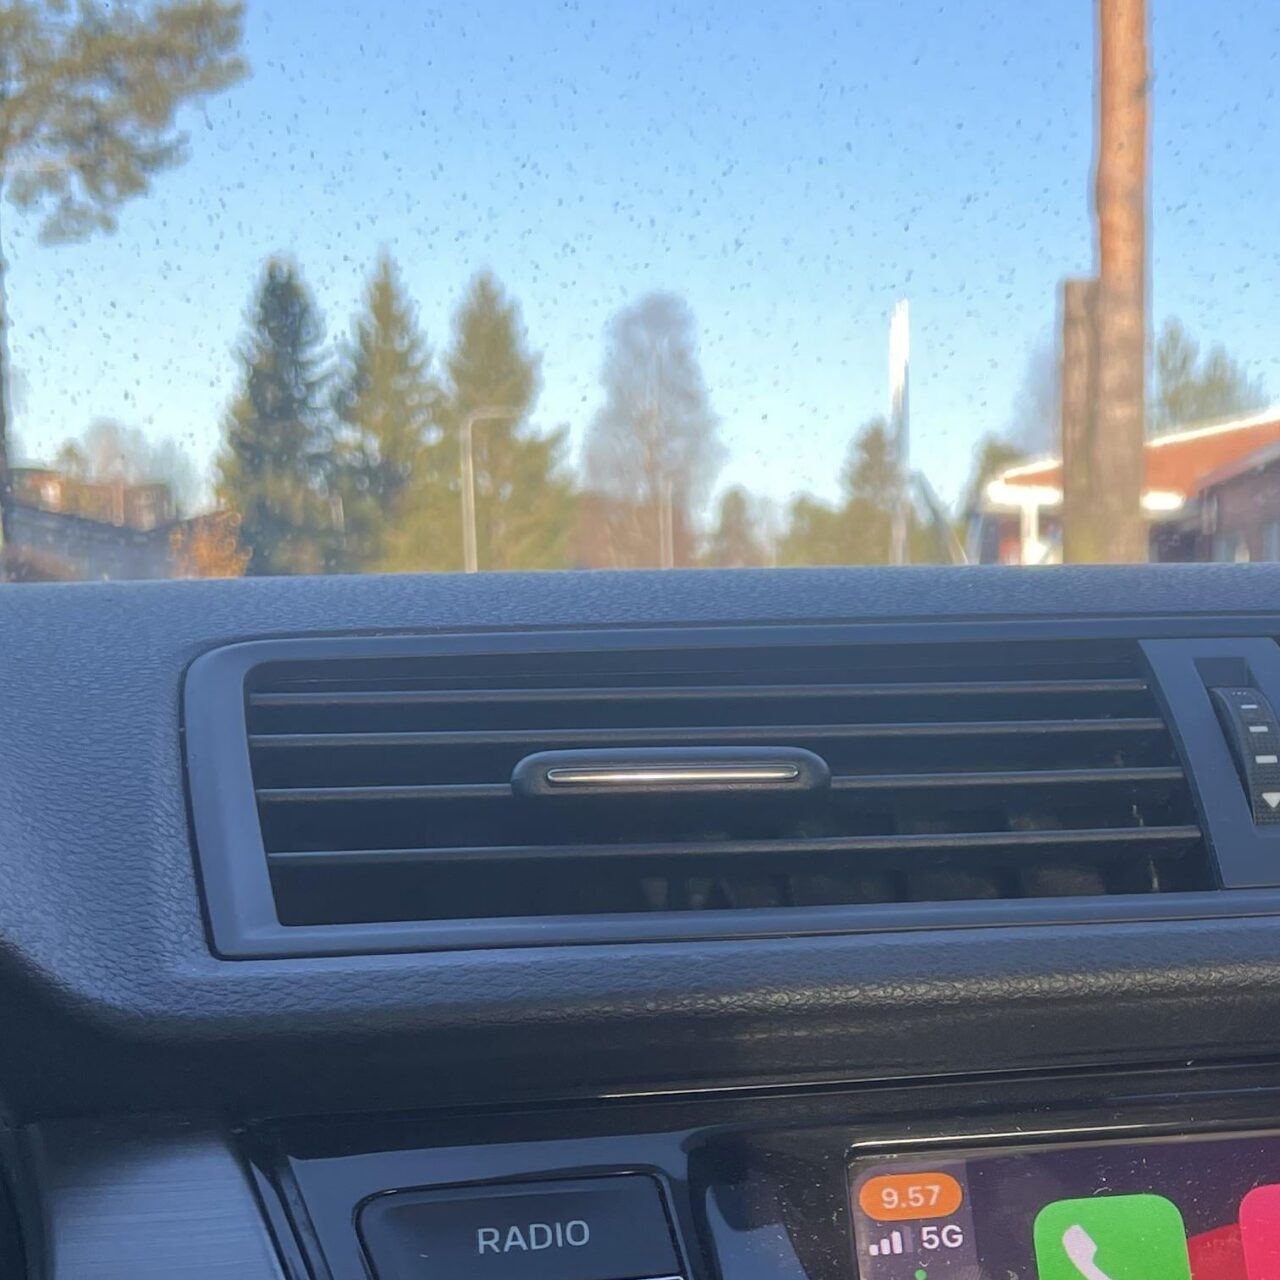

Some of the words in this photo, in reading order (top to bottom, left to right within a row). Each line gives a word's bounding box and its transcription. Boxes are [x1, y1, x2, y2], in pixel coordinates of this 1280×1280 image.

[881, 1184, 941, 1209] 9.57
[476, 1219, 591, 1255] RADIO
[921, 1224, 964, 1250] 5G
